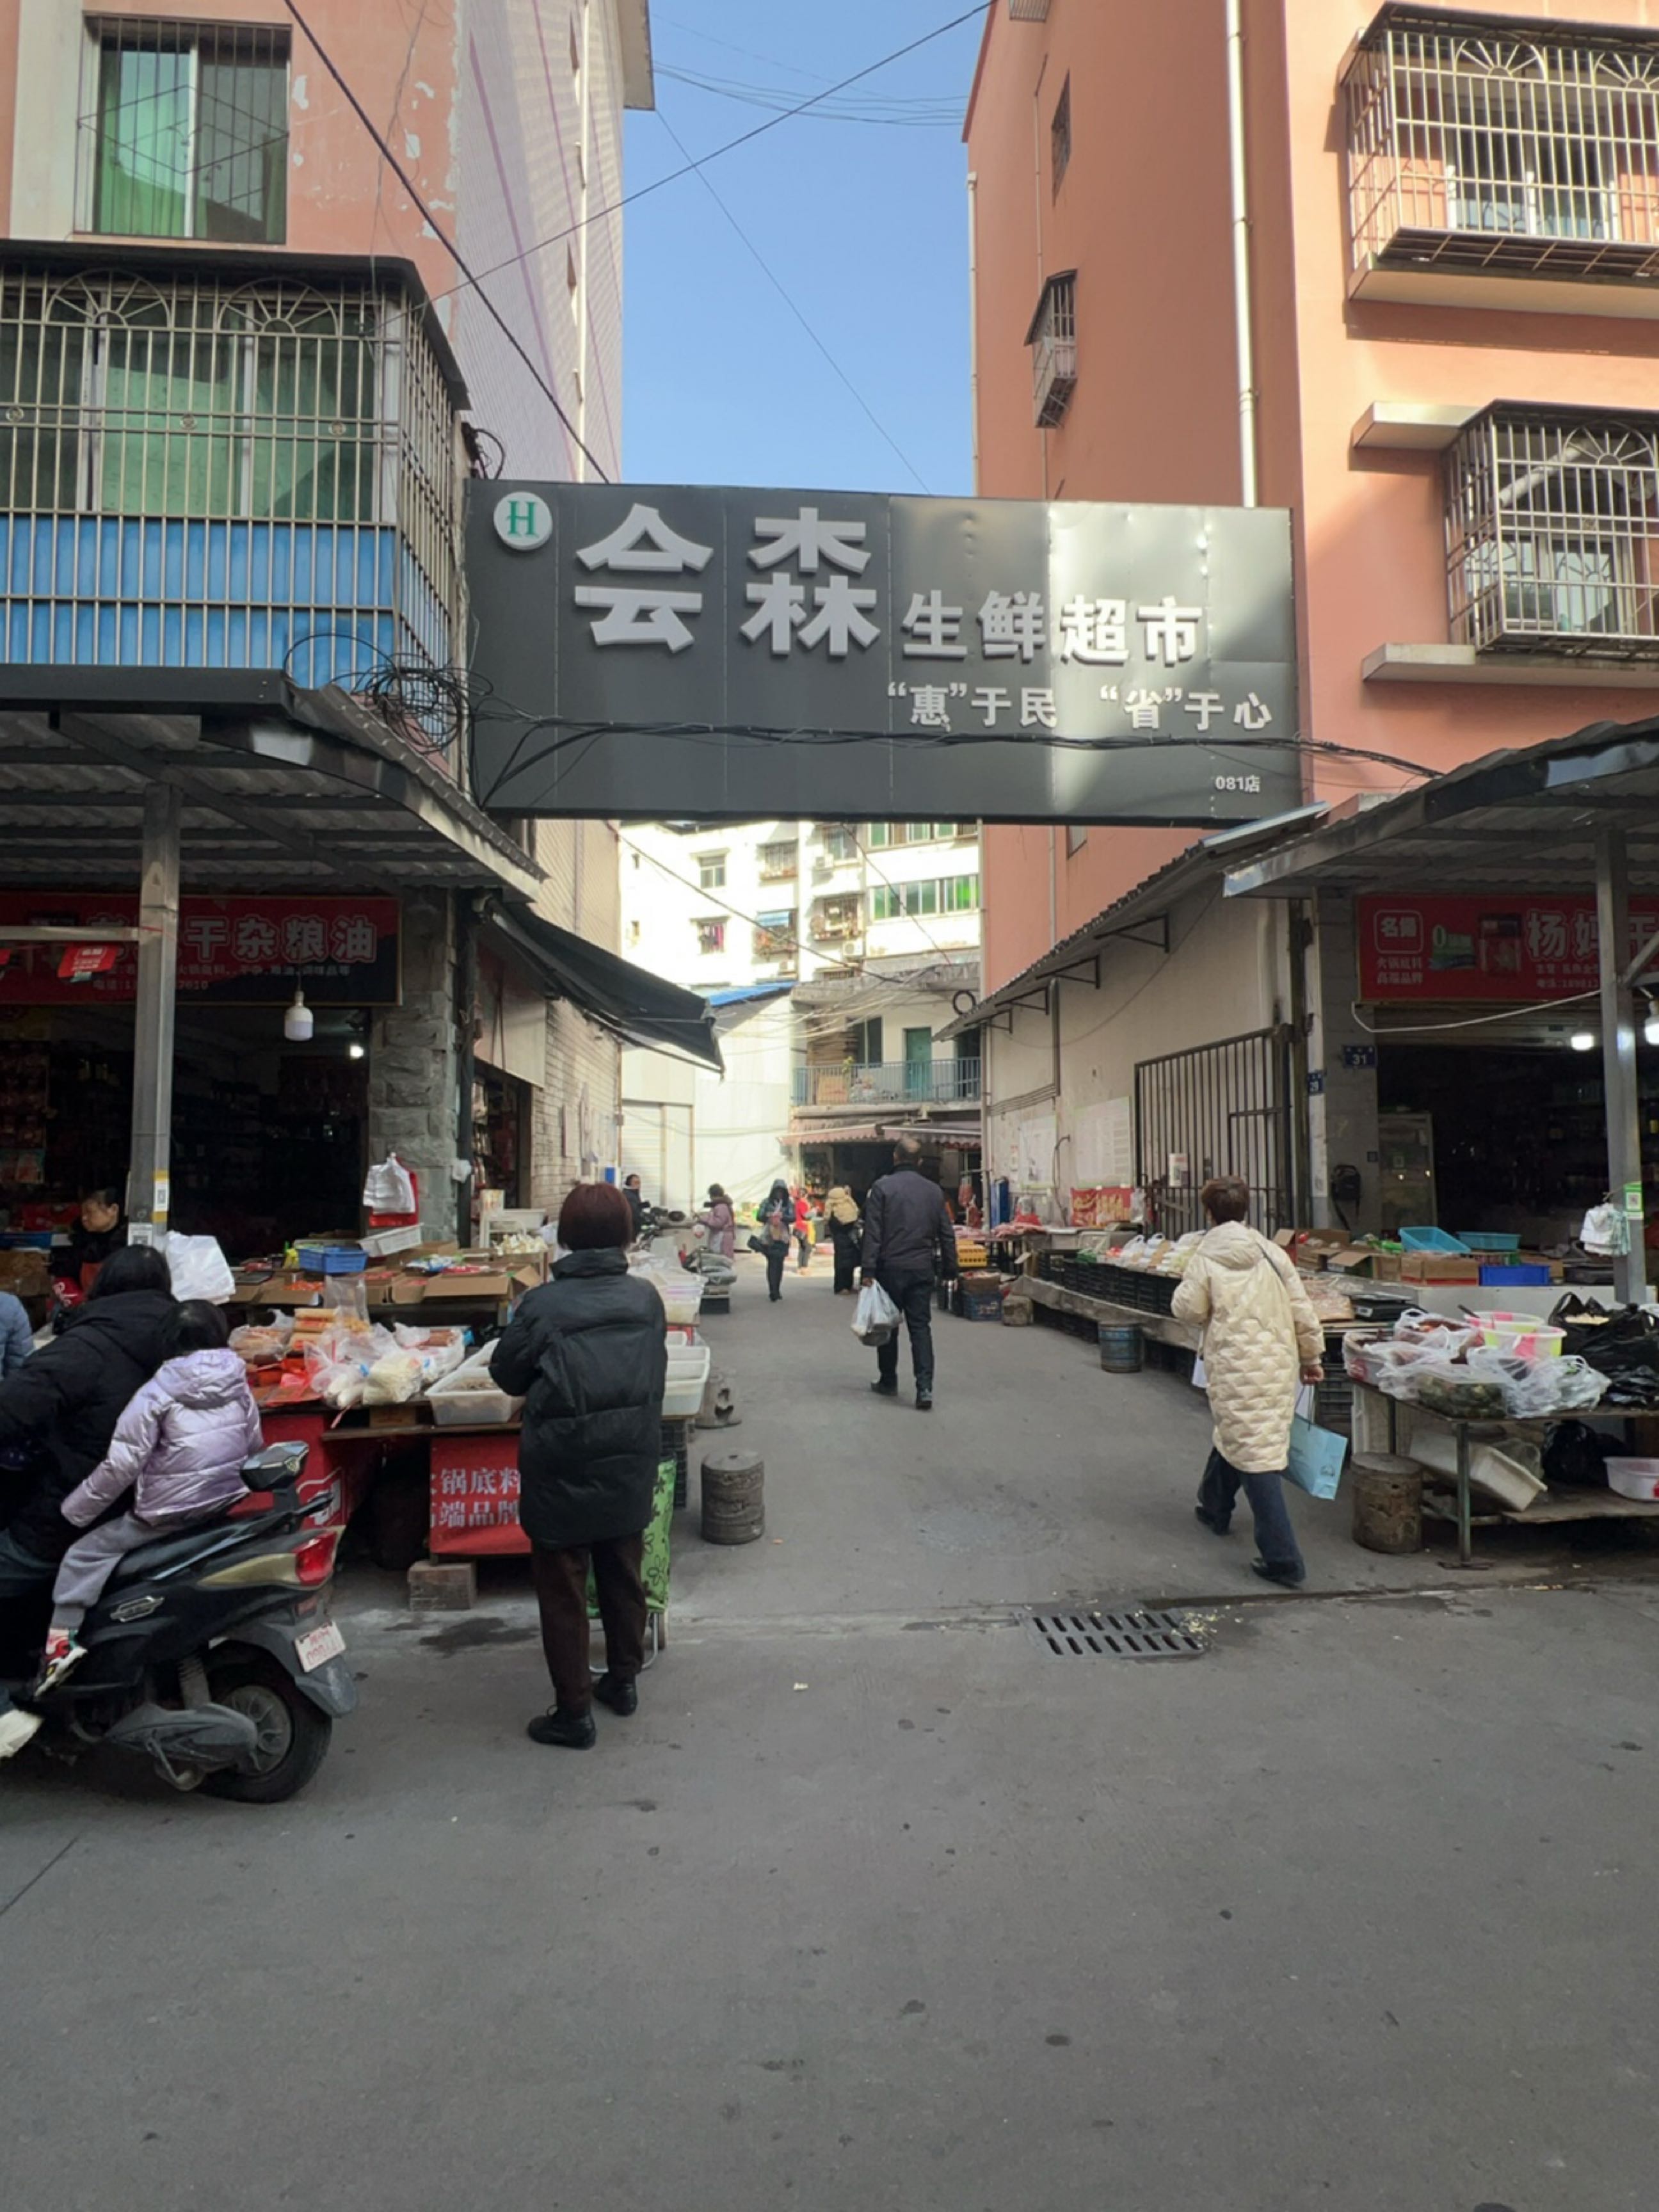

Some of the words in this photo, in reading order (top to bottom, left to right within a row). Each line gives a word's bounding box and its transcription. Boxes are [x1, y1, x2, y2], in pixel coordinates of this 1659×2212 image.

[507, 500, 540, 538] H
[902, 589, 1202, 666] 生鲜超市
[1215, 775, 1260, 794] 081店
[89, 915, 377, 960] 干杂粮油
[1351, 1054, 1368, 1066] 31
[430, 1466, 521, 1495] 锅底料
